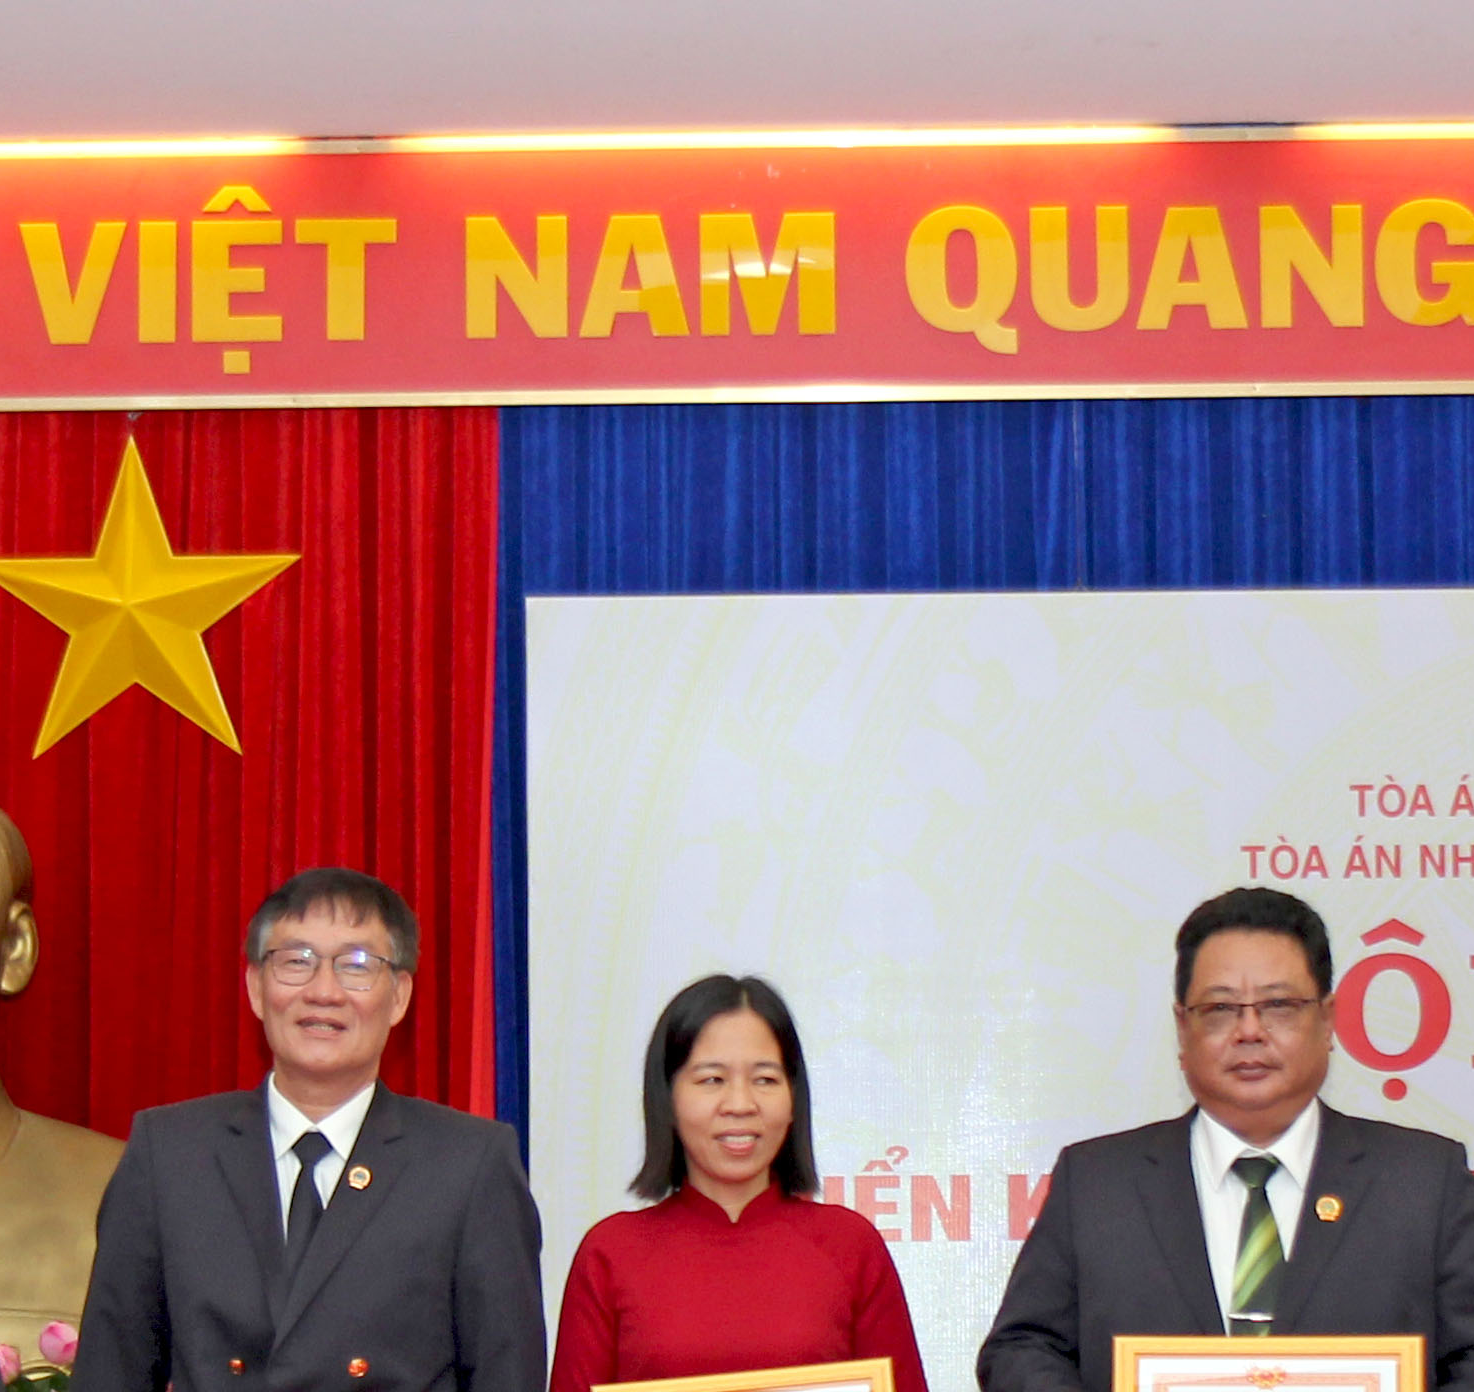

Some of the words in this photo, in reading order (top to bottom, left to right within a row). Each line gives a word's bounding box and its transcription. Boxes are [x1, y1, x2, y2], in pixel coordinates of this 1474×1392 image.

[18, 184, 398, 374] VIỆT
[464, 211, 836, 339] NAM
[1351, 774, 1436, 818] TÒA
[1240, 835, 1329, 880] TÒA
[1345, 839, 1403, 878] ÁN
